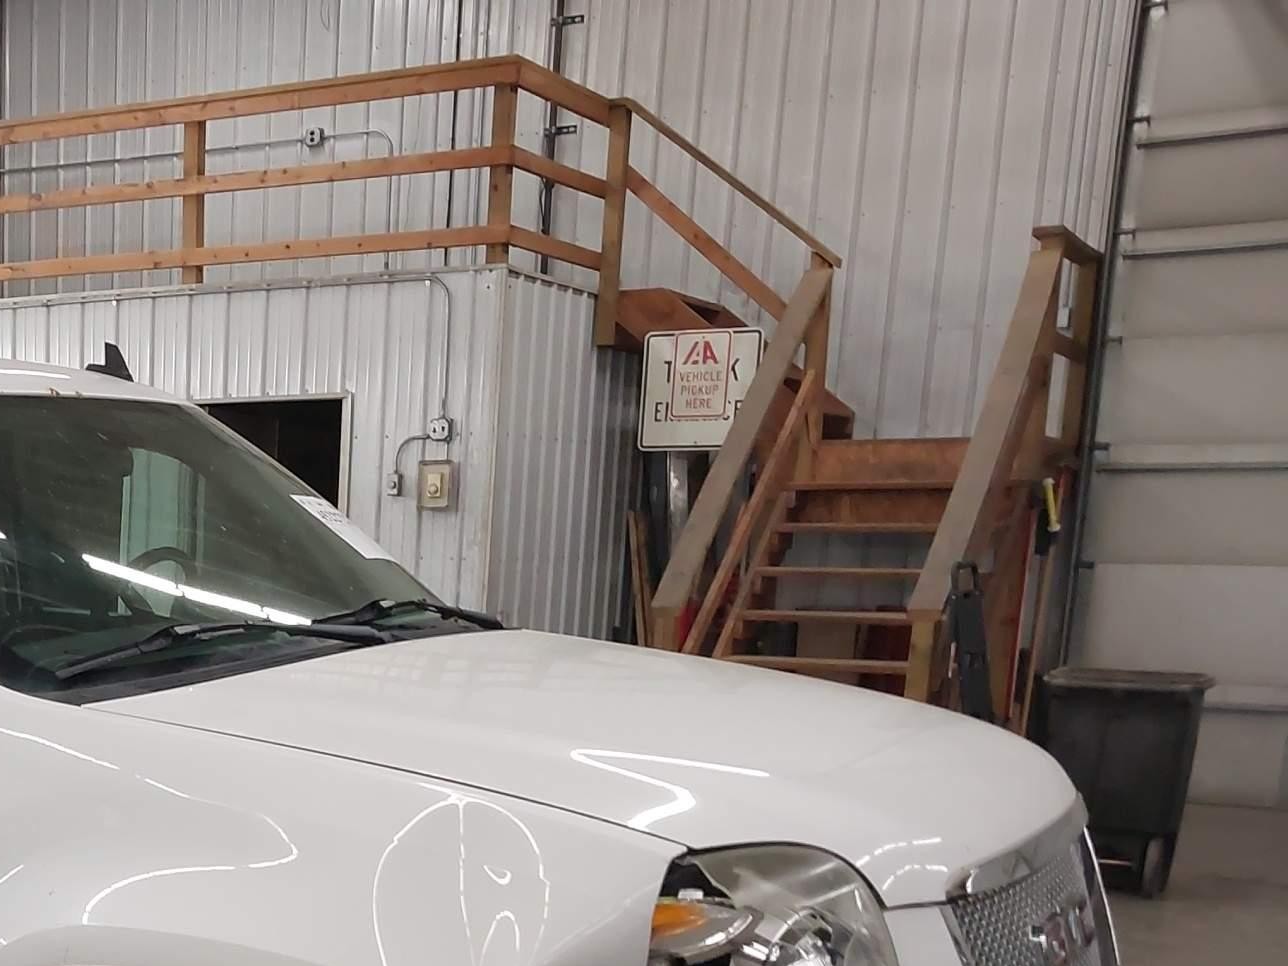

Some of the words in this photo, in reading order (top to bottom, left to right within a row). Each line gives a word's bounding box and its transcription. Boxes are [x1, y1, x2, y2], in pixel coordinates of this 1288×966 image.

[679, 371, 722, 382] VEHICLE
[680, 384, 719, 396] PICKUP
[685, 398, 713, 409] HERE
